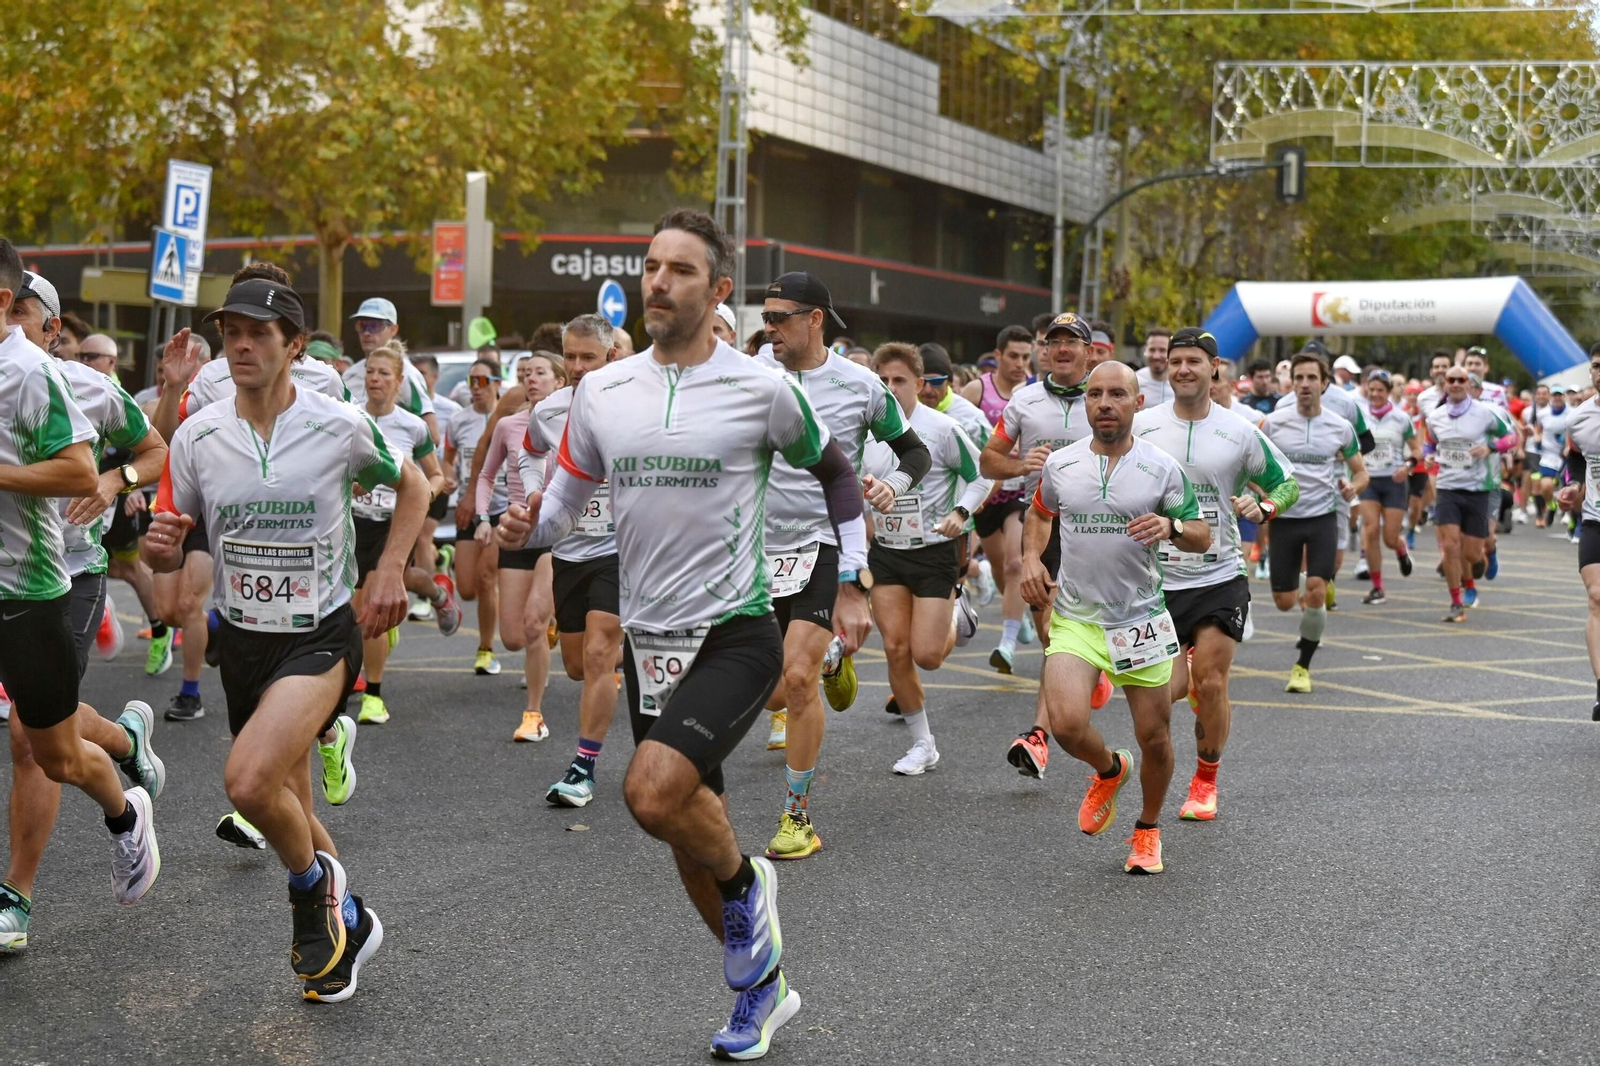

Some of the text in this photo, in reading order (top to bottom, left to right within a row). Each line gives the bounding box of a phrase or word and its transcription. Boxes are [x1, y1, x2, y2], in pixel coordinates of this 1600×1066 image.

[177, 187, 197, 225] P
[551, 248, 645, 281] cajasu
[1359, 299, 1436, 312] Diputación
[1358, 313, 1437, 326] de Córdoba
[715, 376, 739, 388] SIG
[829, 377, 845, 388] SIG
[304, 420, 323, 431] SIG
[1214, 429, 1228, 439] SIG
[612, 455, 723, 473] XII SUBIDA
[1135, 462, 1149, 473] SIG
[618, 475, 719, 488] A LAS ERMITAS
[1191, 483, 1219, 495] BIDA
[217, 500, 317, 520] XII SUBIDA
[225, 518, 314, 532] A LAS ERMITAS
[885, 516, 903, 533] 67
[1070, 513, 1131, 524] XII SUBID
[1081, 526, 1099, 534] LAS
[1100, 526, 1127, 535] ERMIT
[233, 545, 257, 555] SUBIDA
[257, 547, 263, 556] A
[264, 547, 277, 556] LAS
[278, 548, 310, 557] ERMITAS
[226, 553, 236, 561] POR
[236, 555, 242, 563] LA
[242, 556, 272, 566] DONACIÓN
[273, 558, 281, 566] DE
[774, 557, 799, 577] 27
[241, 573, 294, 603] 684
[1128, 622, 1157, 648] 24
[693, 722, 715, 740] asics
